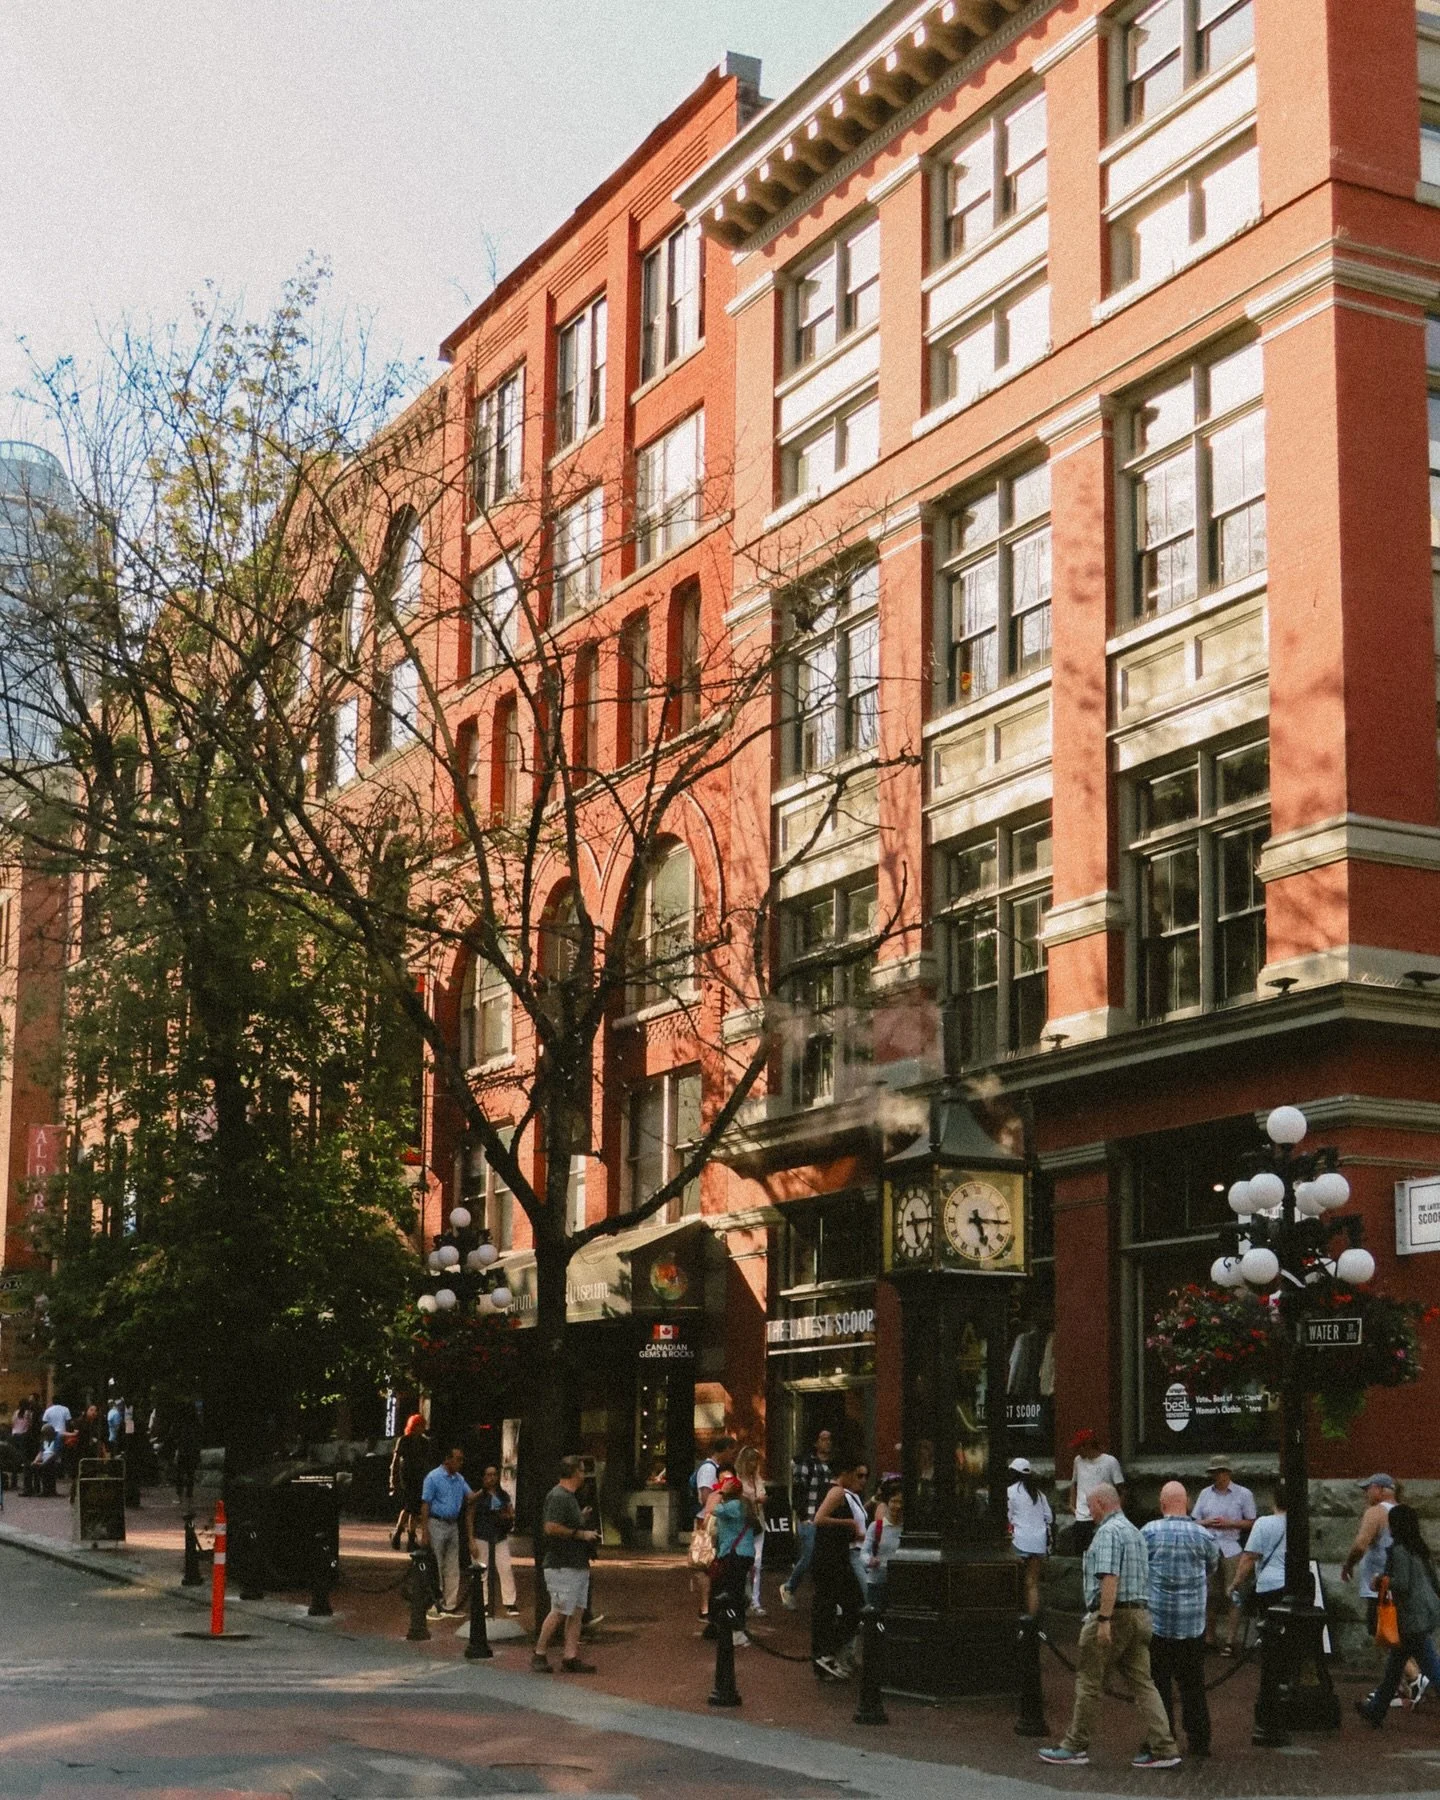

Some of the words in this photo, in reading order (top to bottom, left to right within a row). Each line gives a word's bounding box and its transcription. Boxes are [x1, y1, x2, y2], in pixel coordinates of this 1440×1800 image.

[789, 1314, 832, 1341] LATEST
[835, 1308, 875, 1335] SCOOP
[1309, 1324, 1339, 1341] WATER
[639, 1350, 661, 1358] GEMS
[668, 1350, 695, 1358] ROCKS
[645, 1343, 688, 1351] CANADIAN
[1016, 1404, 1041, 1418] SCOOP
